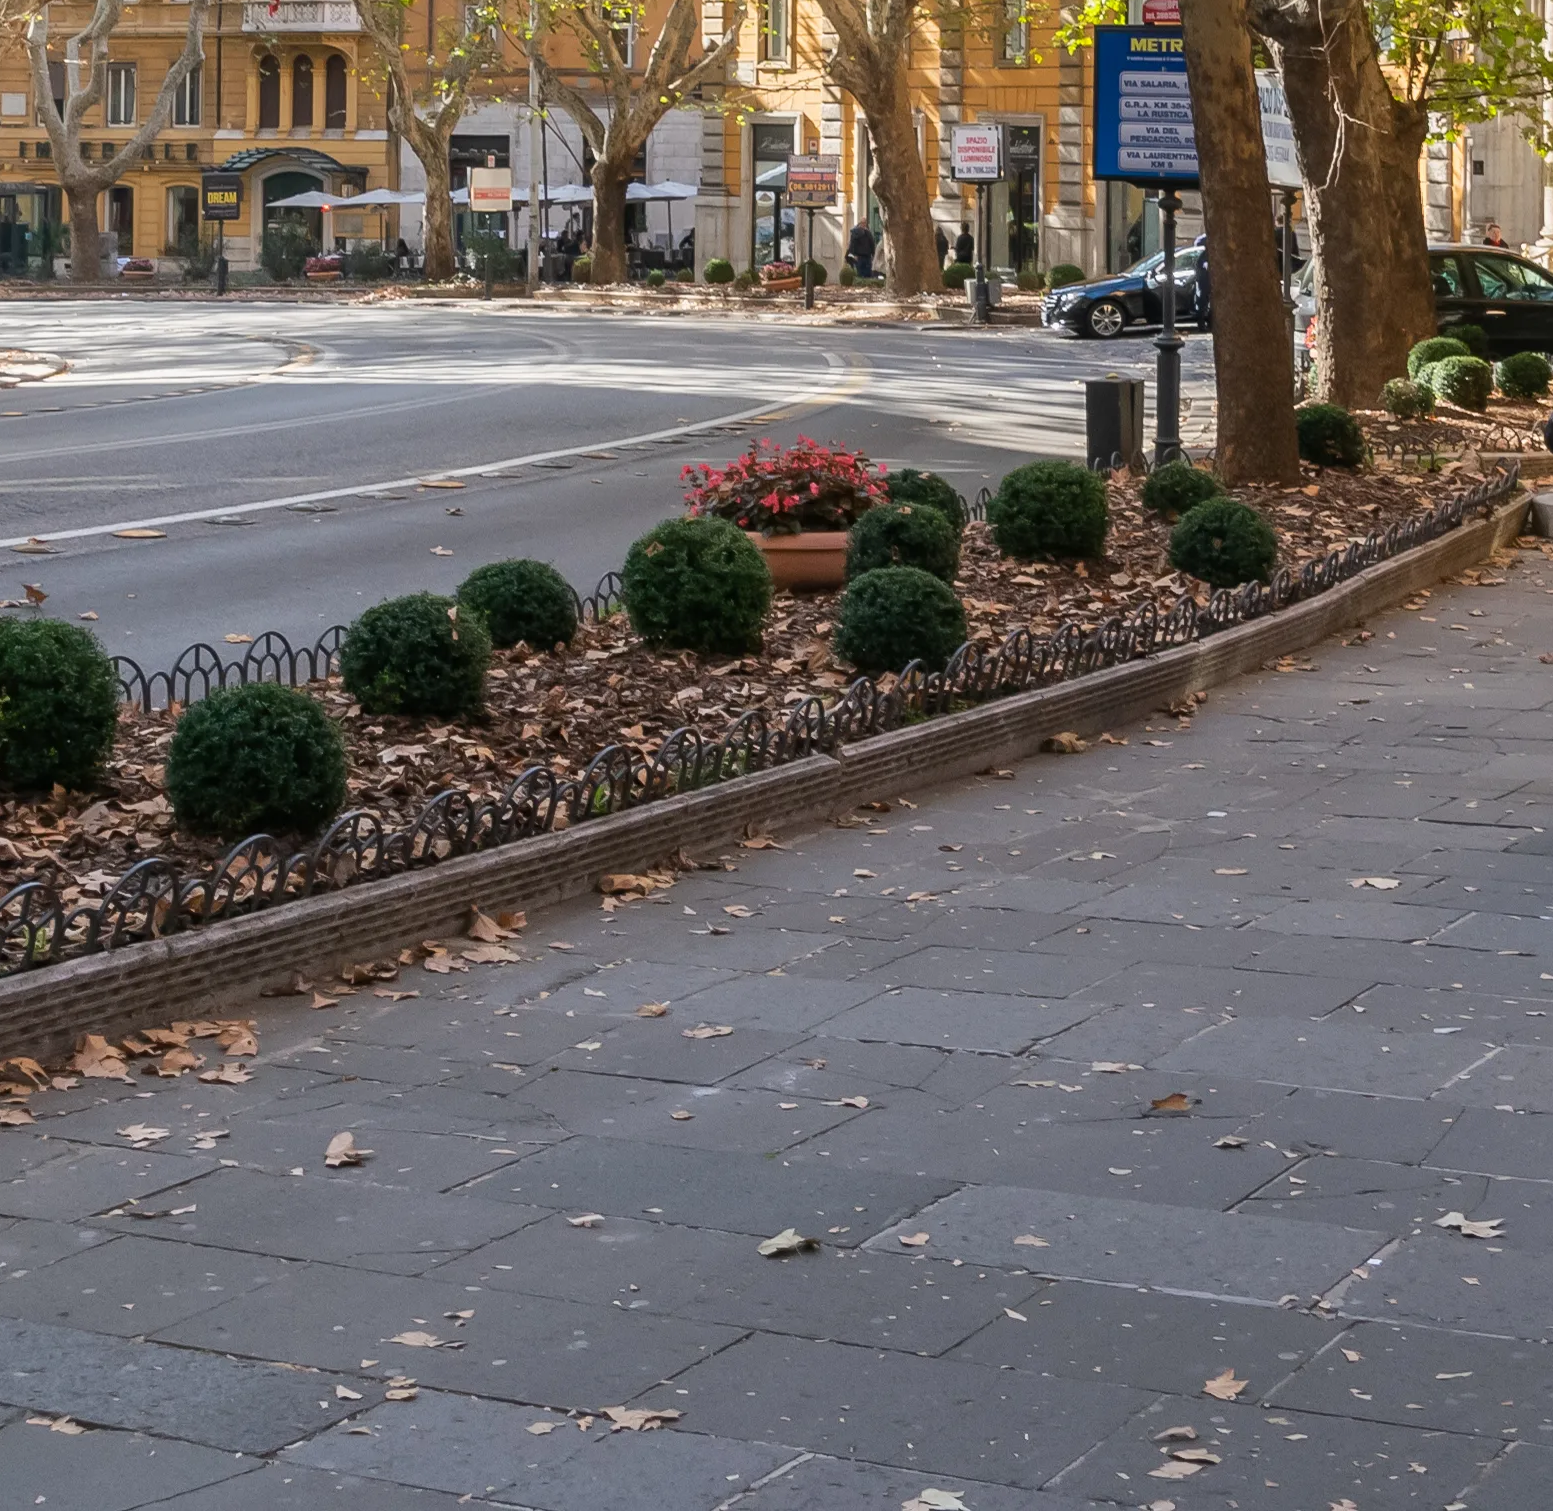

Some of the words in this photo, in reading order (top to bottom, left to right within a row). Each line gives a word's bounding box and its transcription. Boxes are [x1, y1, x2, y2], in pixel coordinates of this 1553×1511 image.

[1130, 38, 1184, 53] METR
[1124, 80, 1138, 88] VIA
[1140, 80, 1180, 89] SALARIA,
[1124, 101, 1152, 109] G.R.A.
[1154, 101, 1168, 109] KM
[1137, 110, 1149, 118] LA
[1151, 110, 1189, 118] RUSTICA
[1162, 127, 1180, 135] DEL
[1129, 135, 1182, 144] PESCACCIO,
[957, 146, 996, 154] DISPONIBILE
[960, 155, 993, 163] LUMINOSO
[1126, 151, 1141, 159] VIA
[1143, 152, 1198, 161] LAURENTINA
[207, 191, 237, 204] DREAM
